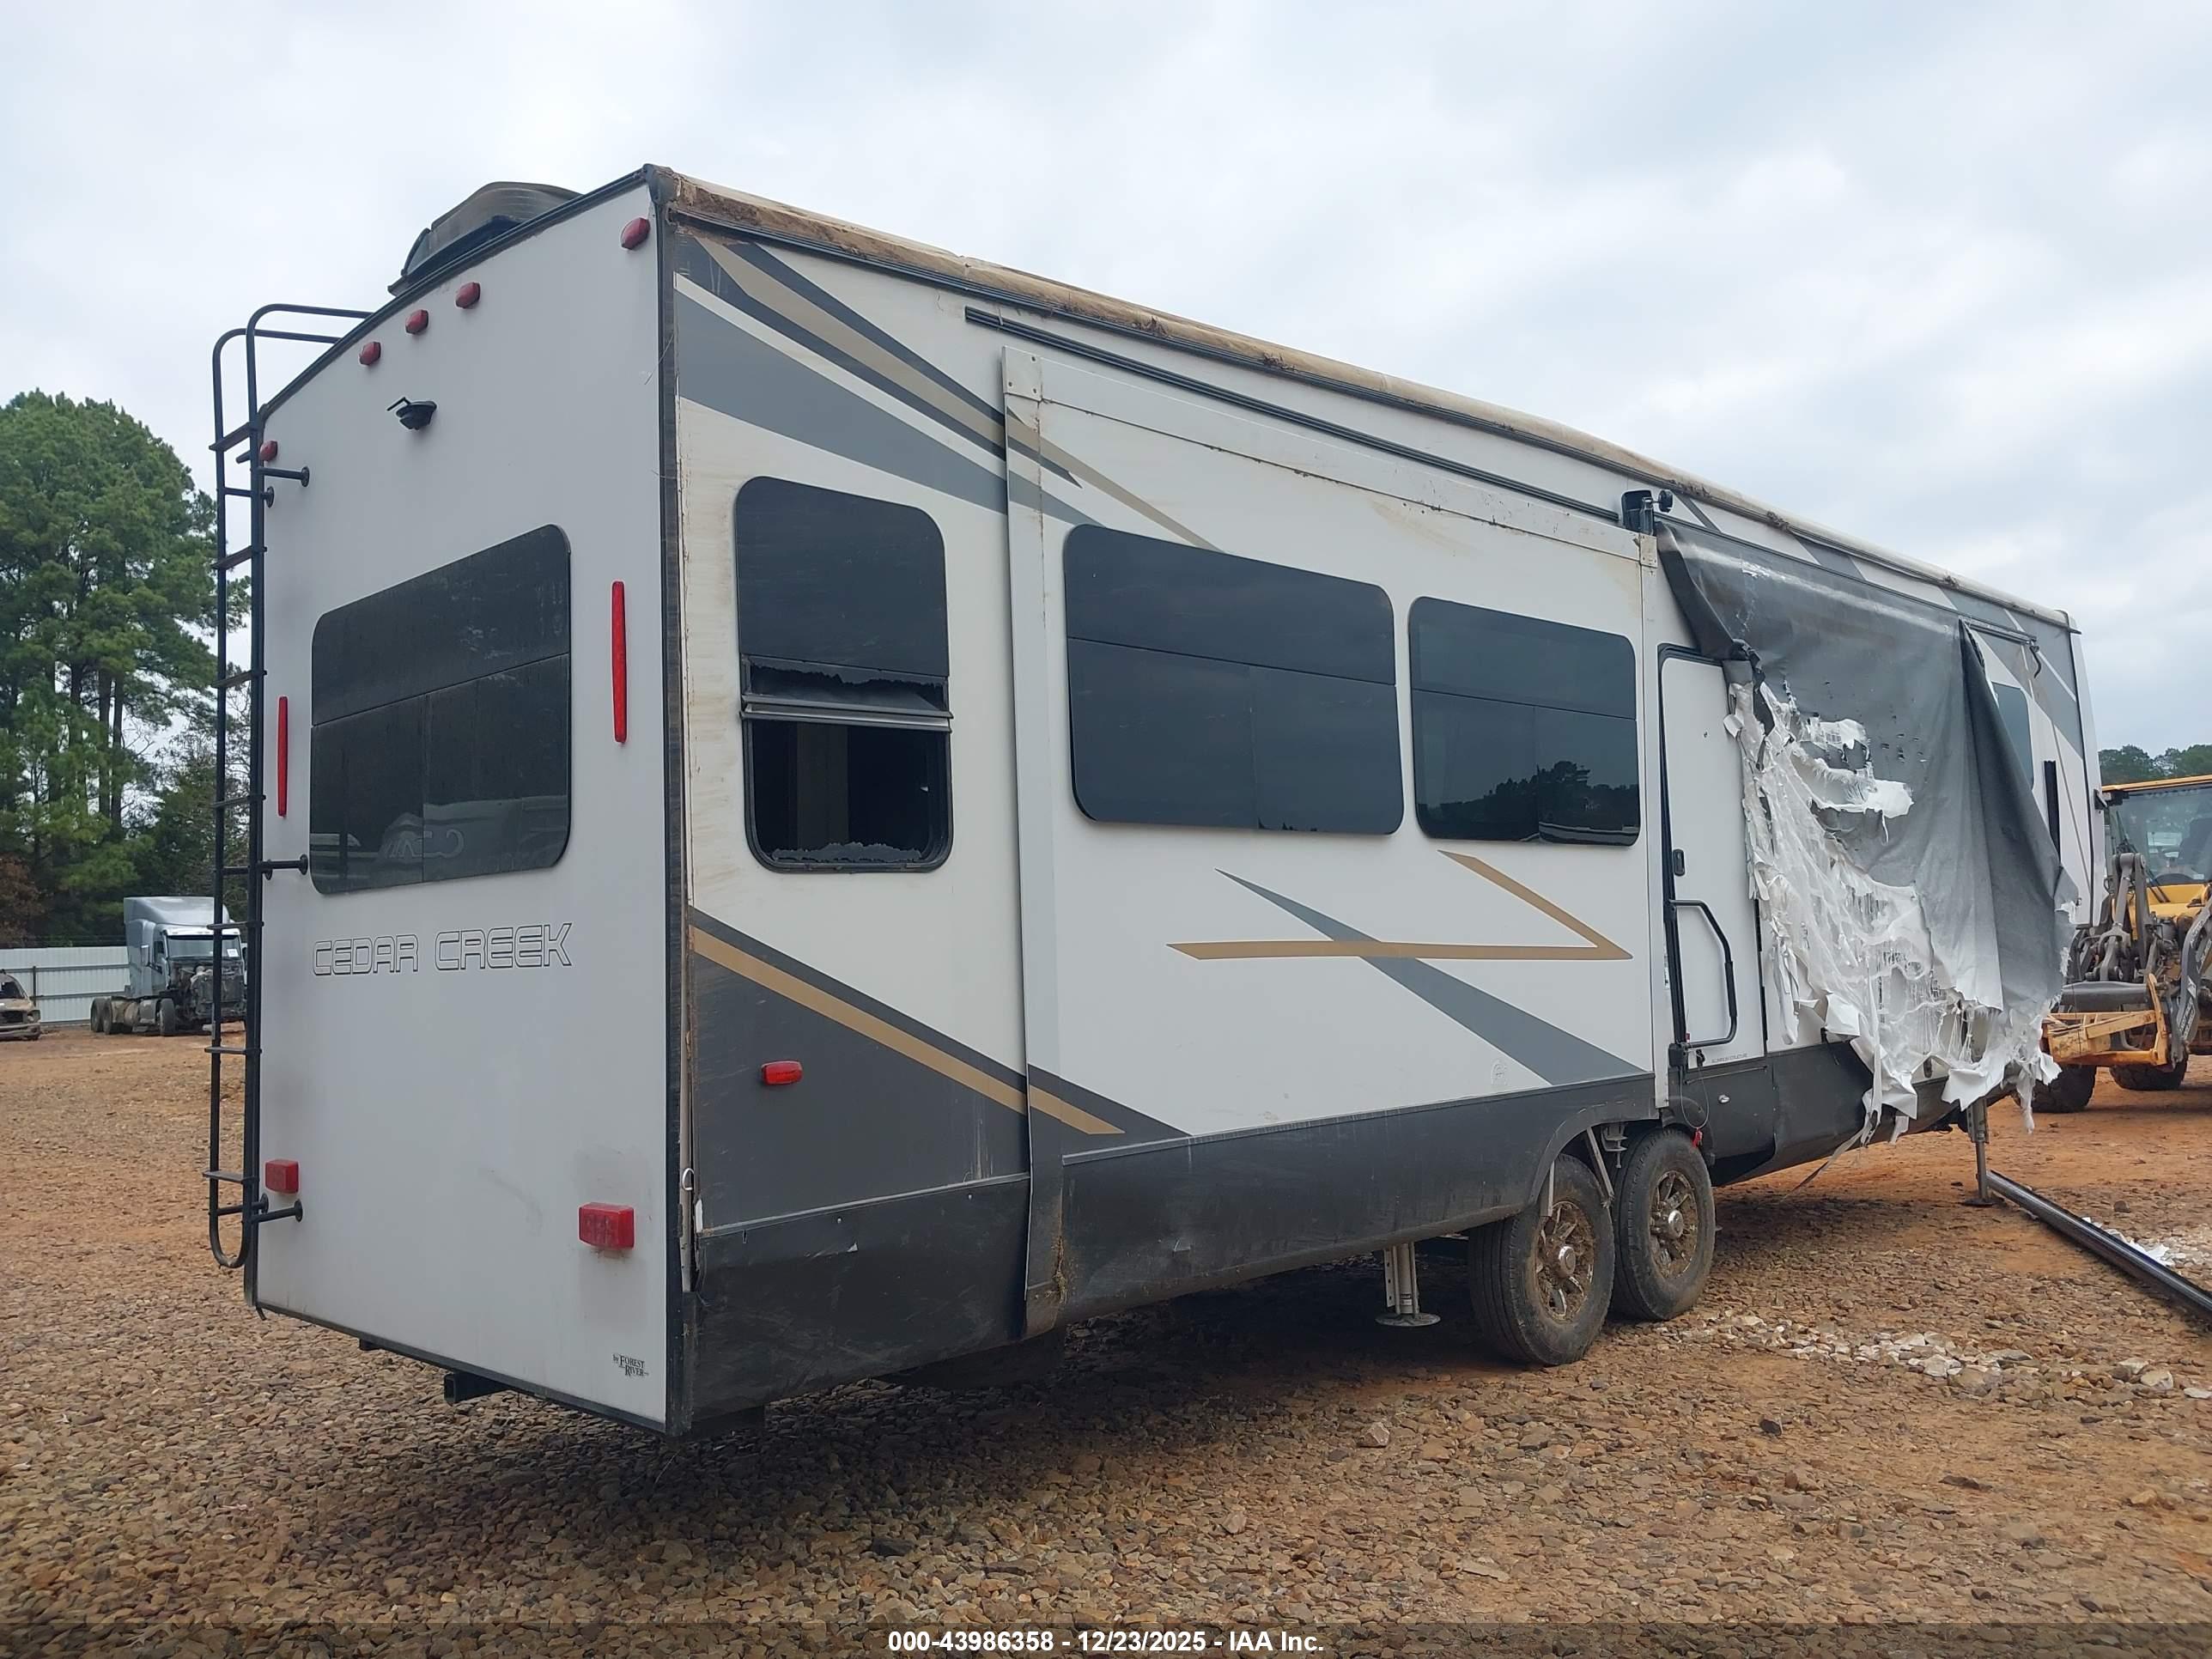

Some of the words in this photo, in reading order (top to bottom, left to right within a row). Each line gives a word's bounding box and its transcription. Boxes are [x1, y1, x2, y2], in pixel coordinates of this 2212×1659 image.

[313, 933, 419, 976] CEDAR
[434, 922, 573, 971] CREEK
[619, 1355, 645, 1369] FOREST
[624, 1364, 645, 1376] RIVER
